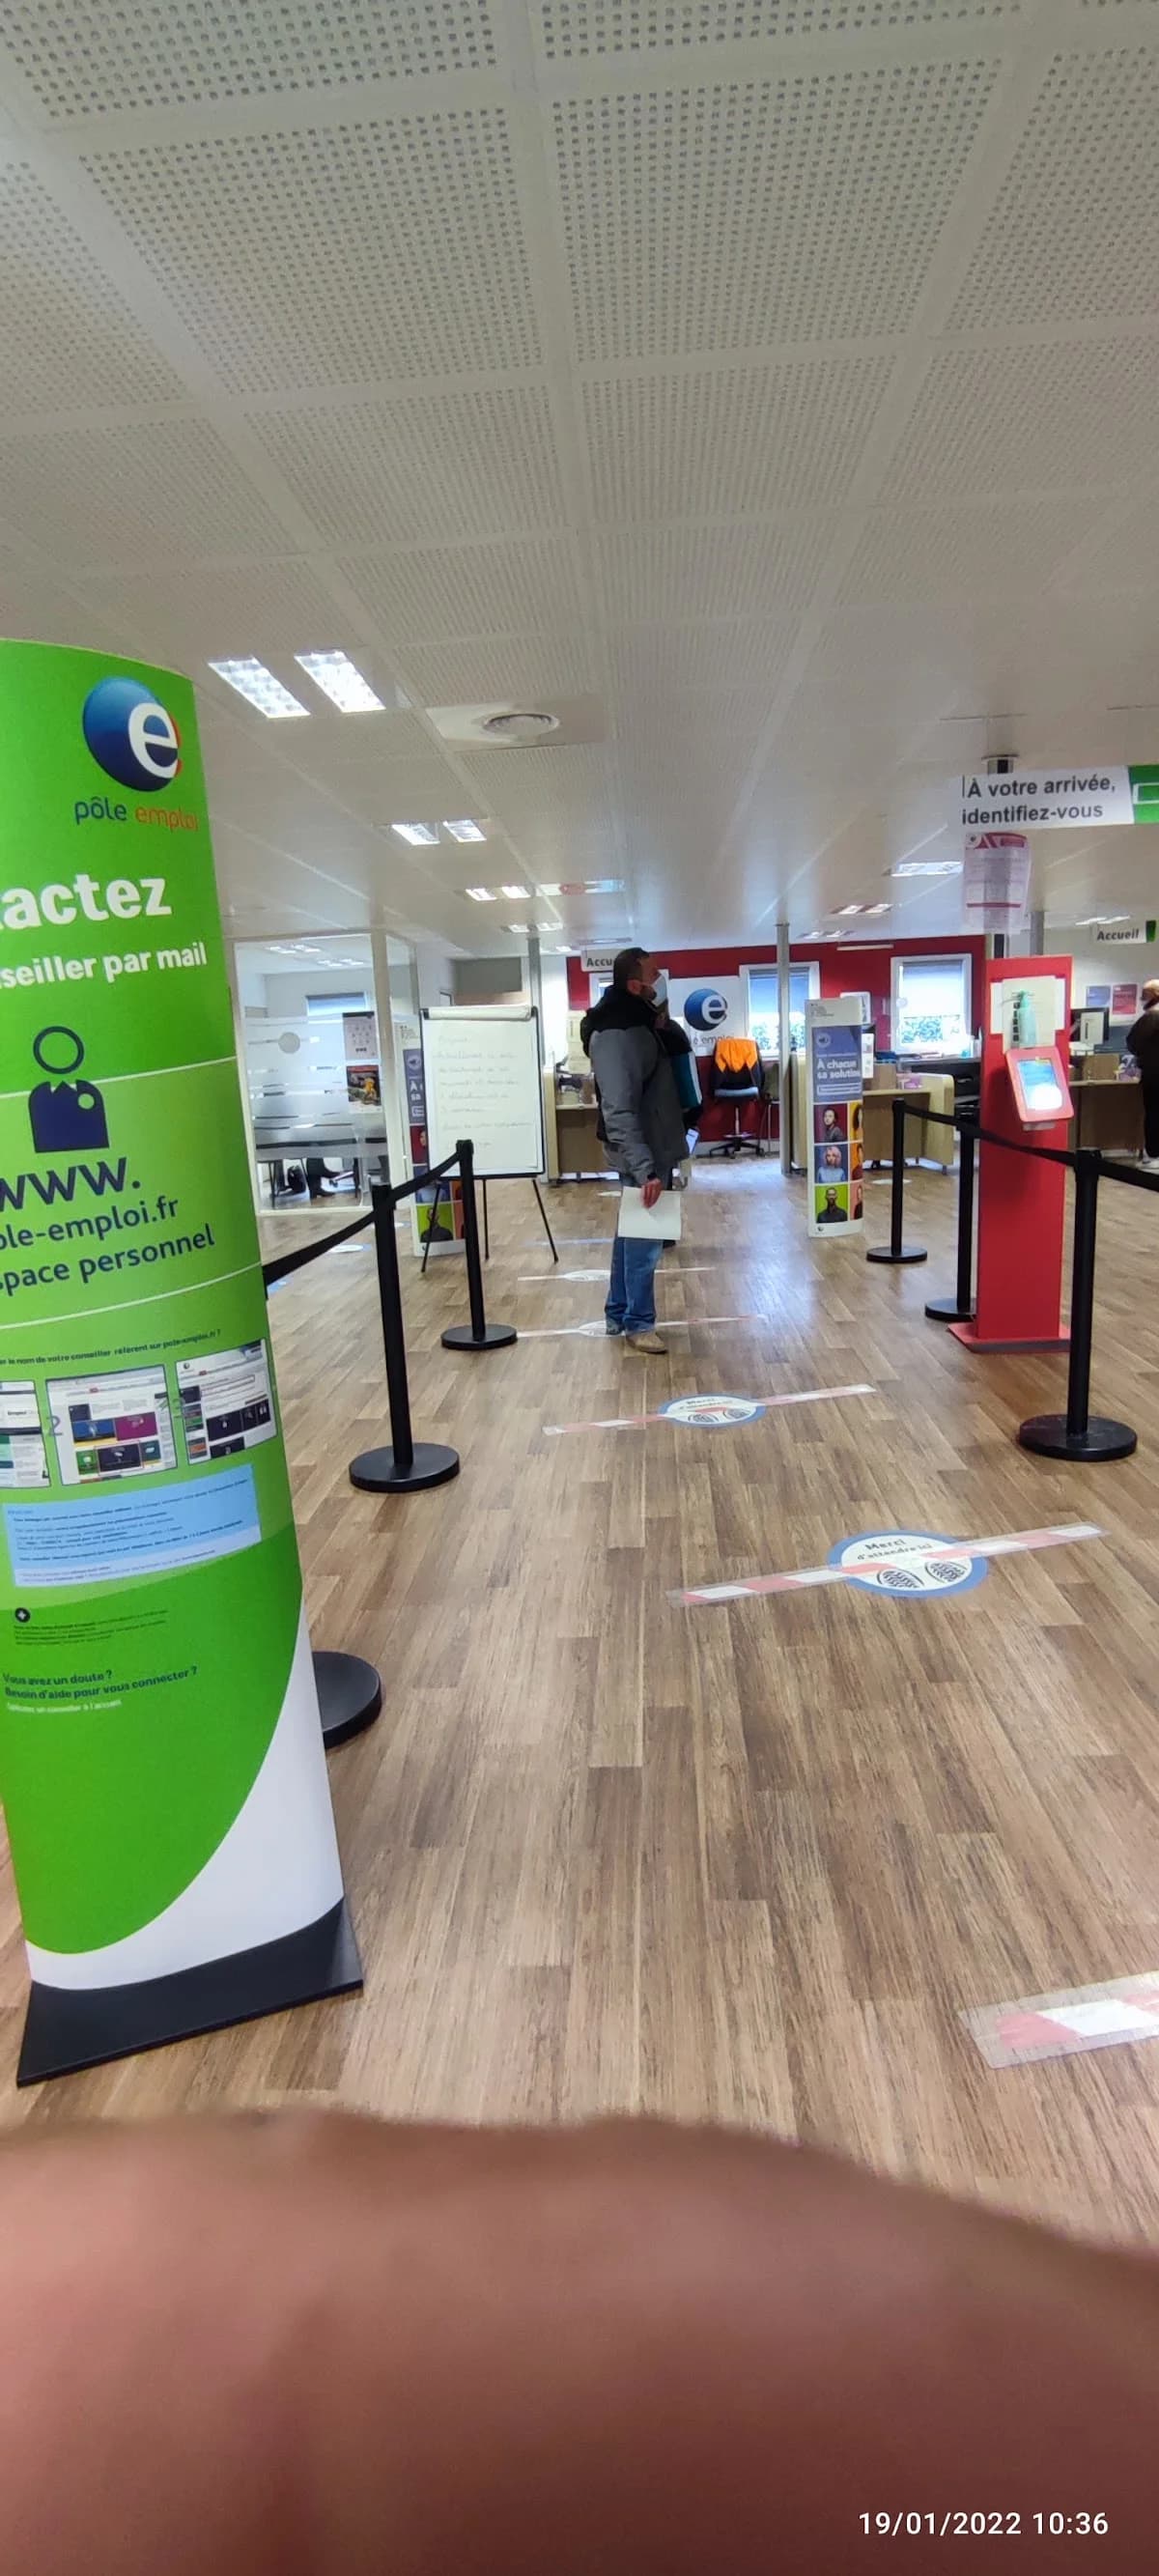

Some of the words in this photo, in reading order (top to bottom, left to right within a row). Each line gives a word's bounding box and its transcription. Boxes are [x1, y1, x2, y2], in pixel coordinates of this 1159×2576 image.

[967, 778, 982, 798] À
[988, 780, 1037, 797] votre
[1044, 774, 1116, 794] arrivée,
[74, 796, 127, 825] pôle
[135, 806, 199, 833] emploi
[962, 805, 1103, 825] identifiez-vous
[0, 874, 172, 930] actez
[1096, 928, 1140, 941] Accueil
[0, 955, 98, 989] seiller
[104, 951, 152, 983] par
[156, 942, 208, 970] mail
[586, 957, 614, 968] Accu
[0, 1263, 71, 1297] pace
[78, 1223, 215, 1285] personnel
[46, 1415, 64, 1436] 2
[858, 1545, 917, 1561] d'attendre
[865, 1539, 906, 1550] Merci
[3, 1673, 26, 1684] Vous
[28, 1677, 51, 1685] avez
[71, 1673, 104, 1684] doute
[106, 1669, 113, 1679] ?
[5, 1686, 38, 1699] Besoin
[39, 1689, 71, 1699] d'aide
[73, 1686, 100, 1700] pour
[103, 1684, 129, 1693] vous
[131, 1670, 189, 1688] connecter
[191, 1665, 197, 1674] ?
